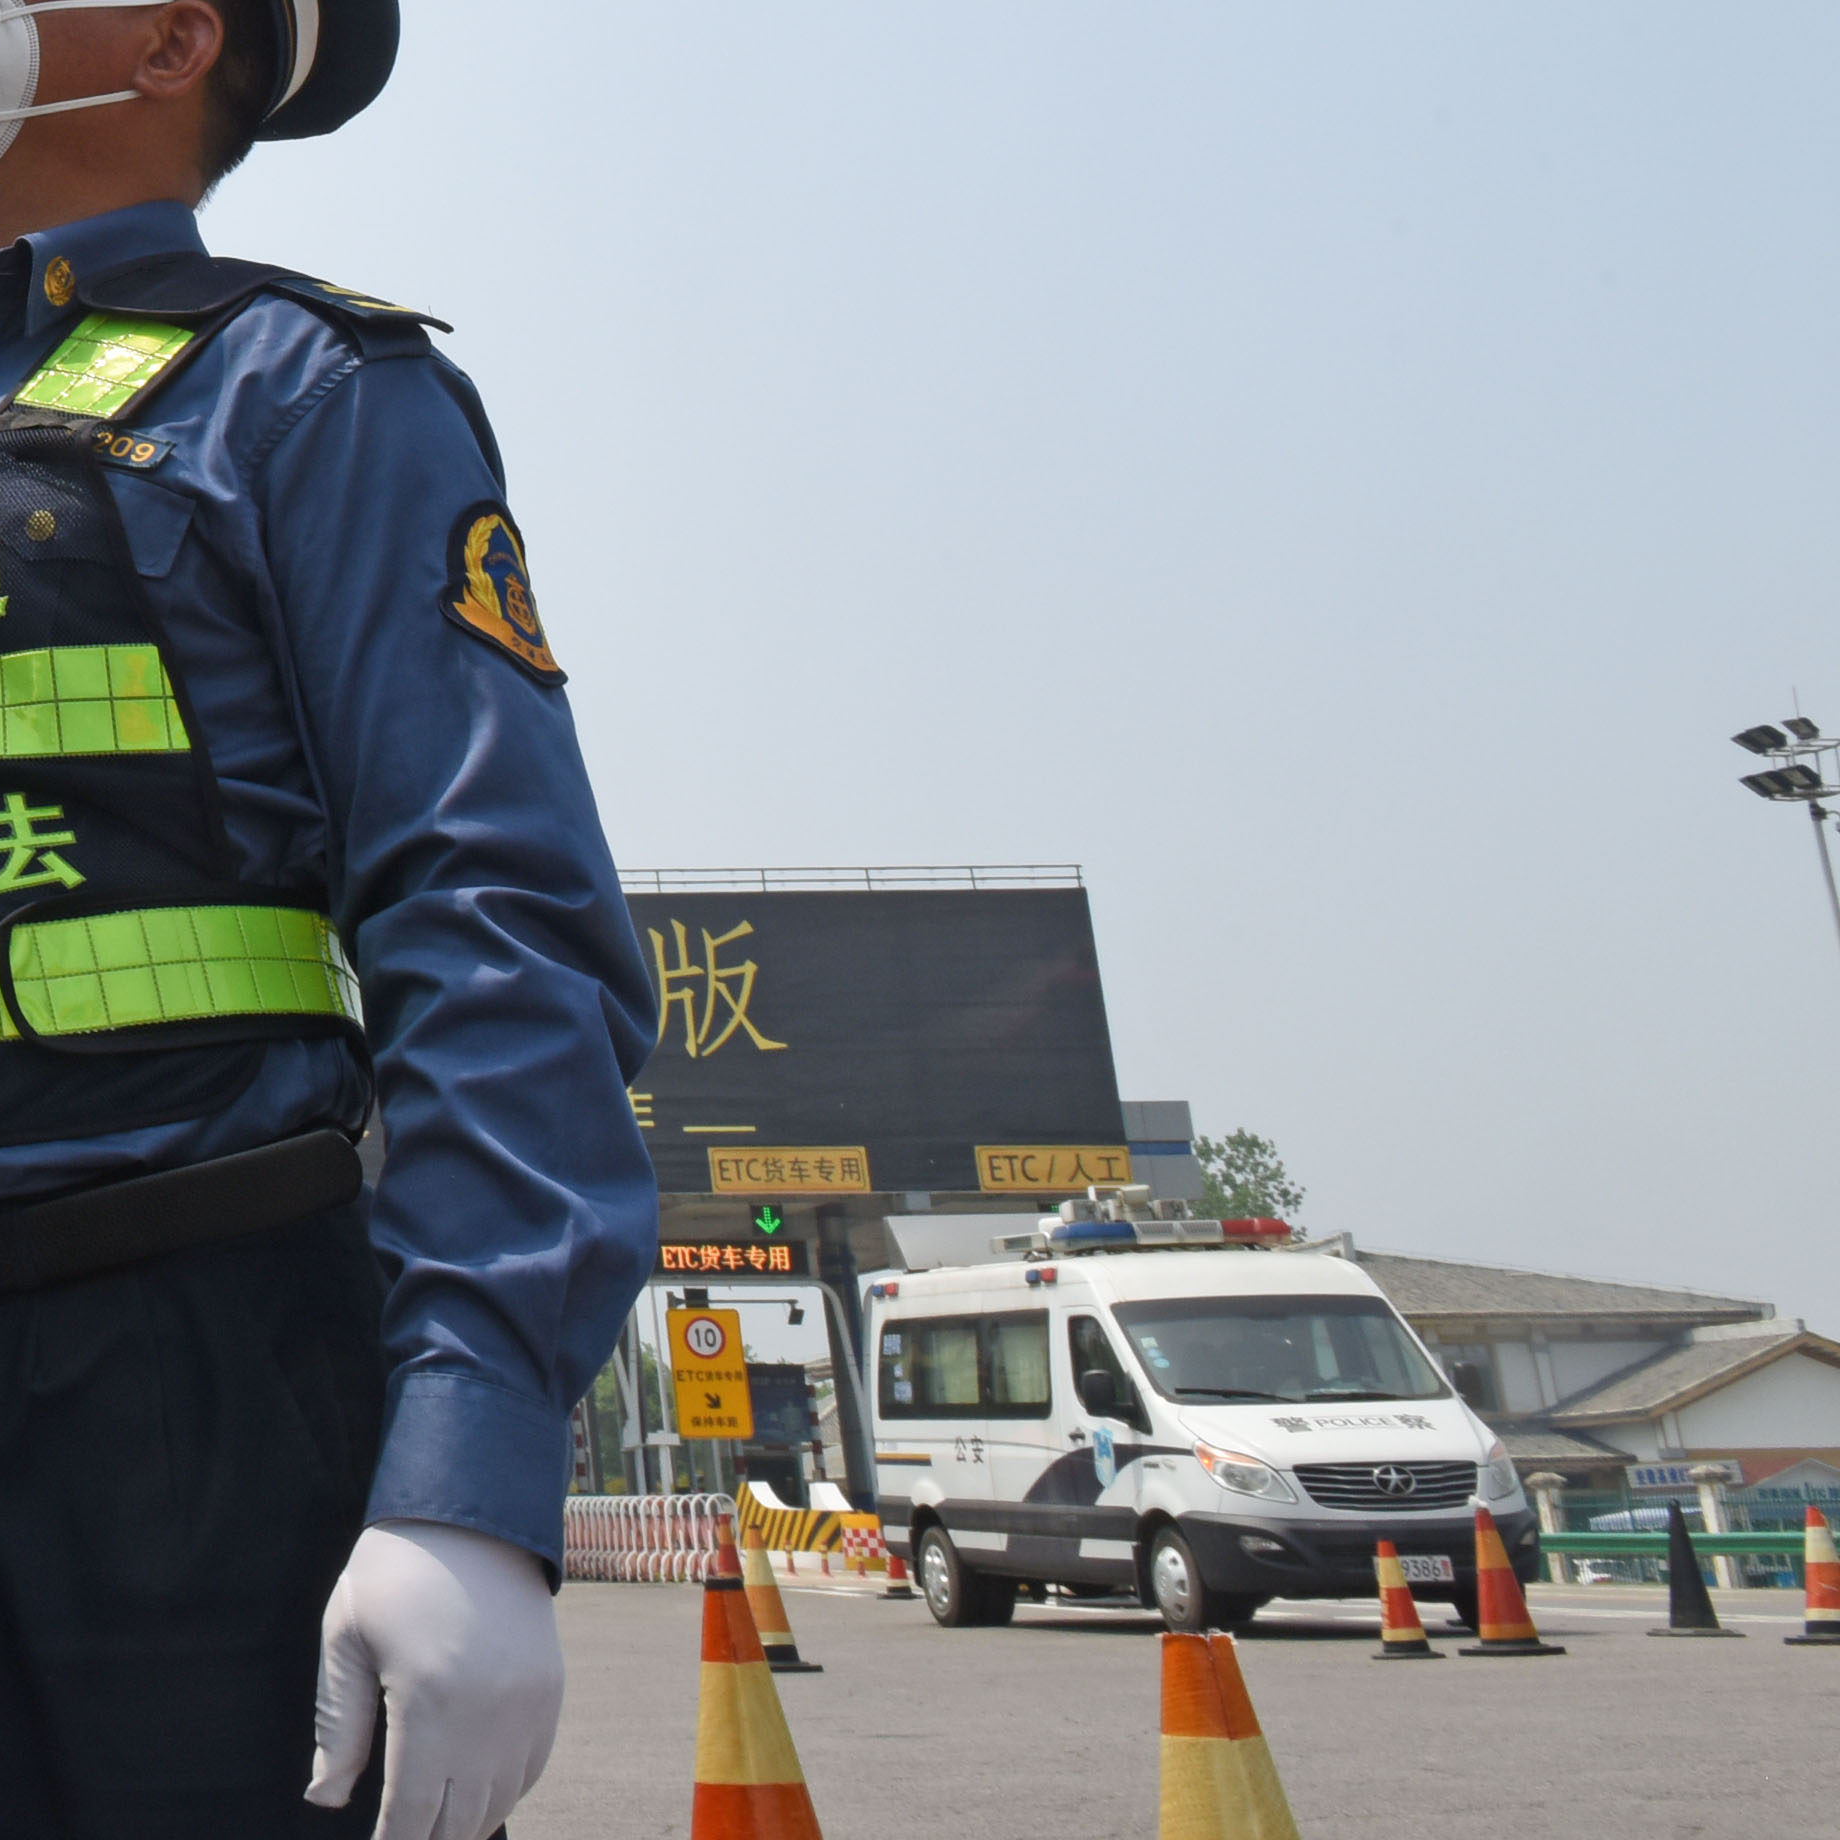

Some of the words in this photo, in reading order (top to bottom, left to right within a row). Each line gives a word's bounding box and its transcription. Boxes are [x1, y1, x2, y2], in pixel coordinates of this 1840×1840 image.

[647, 918, 790, 1058] 版
[718, 1157, 861, 1183] ETC货车专用
[661, 1245, 791, 1271] ETC货车专用
[694, 1327, 717, 1348] 10
[1313, 1417, 1394, 1427] POLICE
[954, 1436, 985, 1465] 公安
